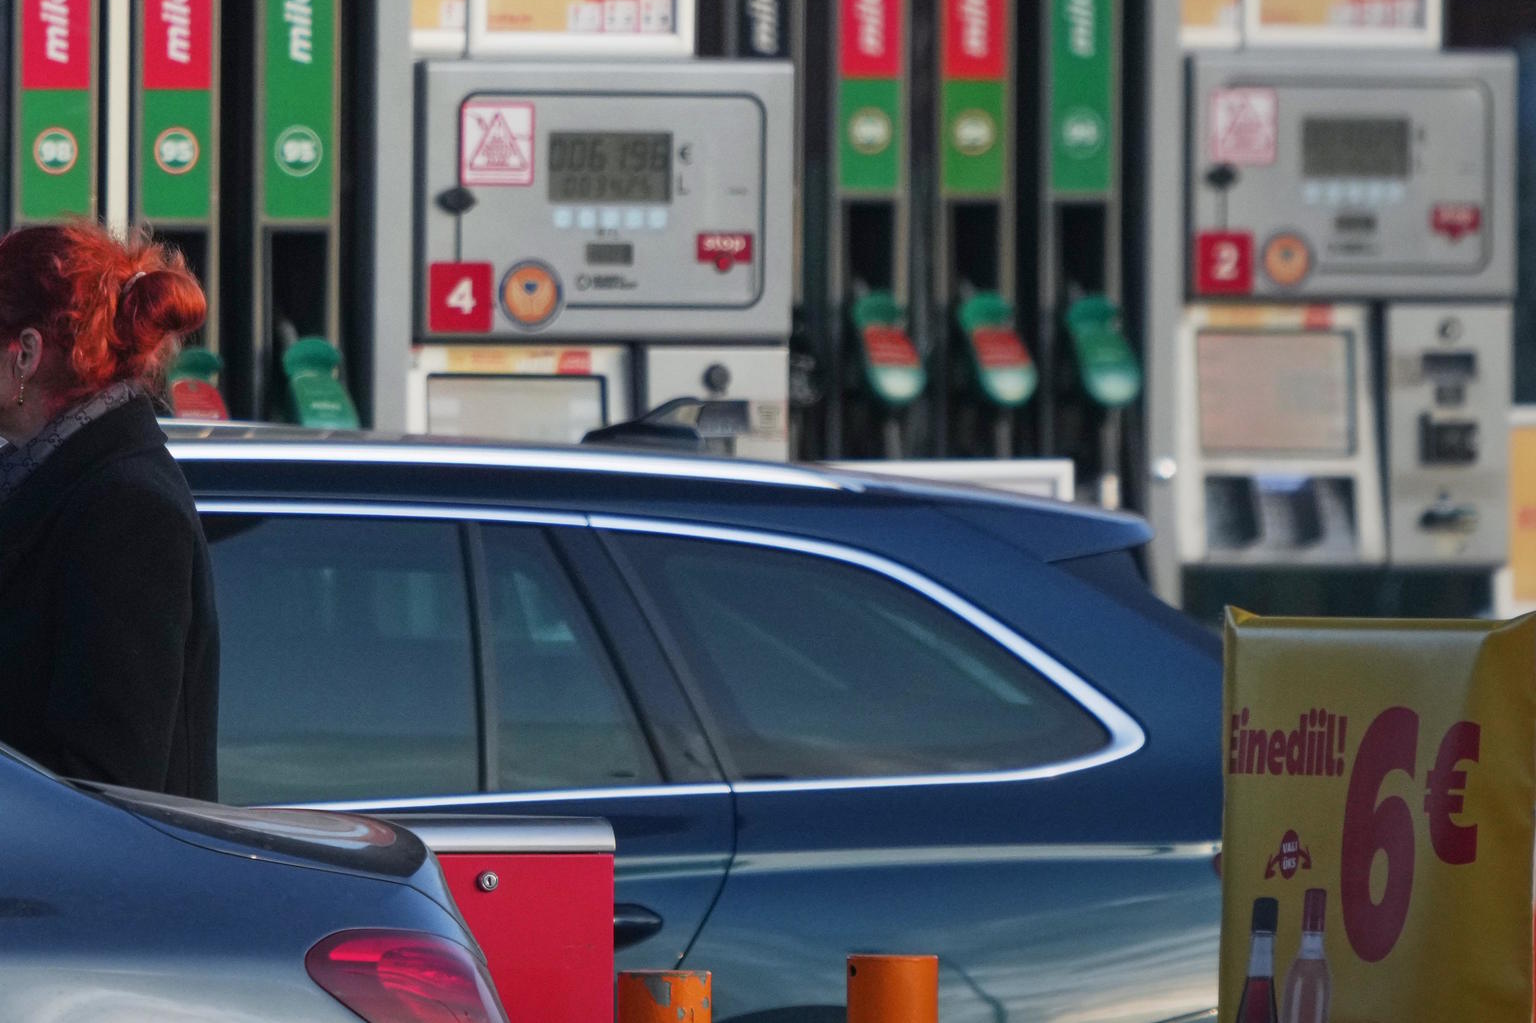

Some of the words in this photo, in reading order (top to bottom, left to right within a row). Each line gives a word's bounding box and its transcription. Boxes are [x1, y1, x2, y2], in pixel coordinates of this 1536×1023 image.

[703, 236, 746, 253] stop
[1213, 242, 1239, 281] 2
[447, 279, 476, 315] 4
[1228, 707, 1348, 777] Einediil!
